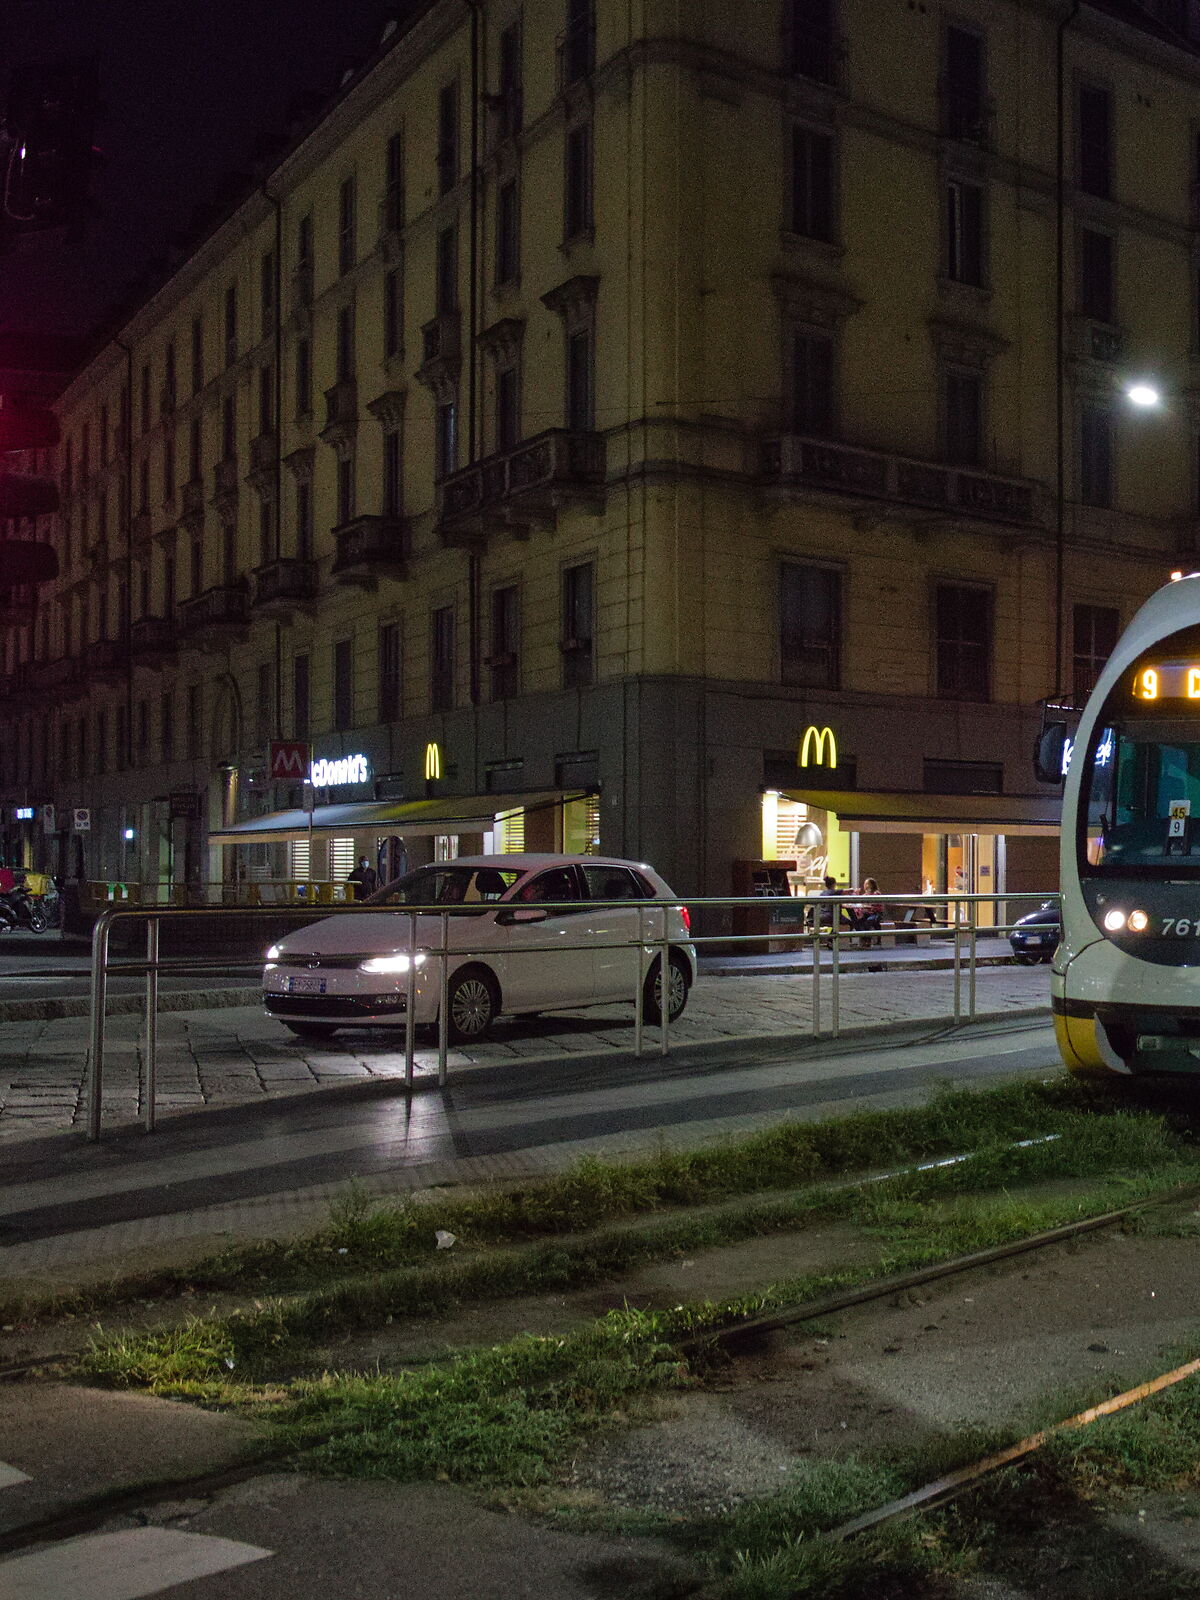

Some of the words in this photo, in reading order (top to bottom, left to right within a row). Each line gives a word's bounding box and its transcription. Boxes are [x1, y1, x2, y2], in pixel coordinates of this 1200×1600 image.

[1142, 669, 1157, 699] 9
[1172, 807, 1186, 819] 45
[1174, 821, 1180, 833] 9
